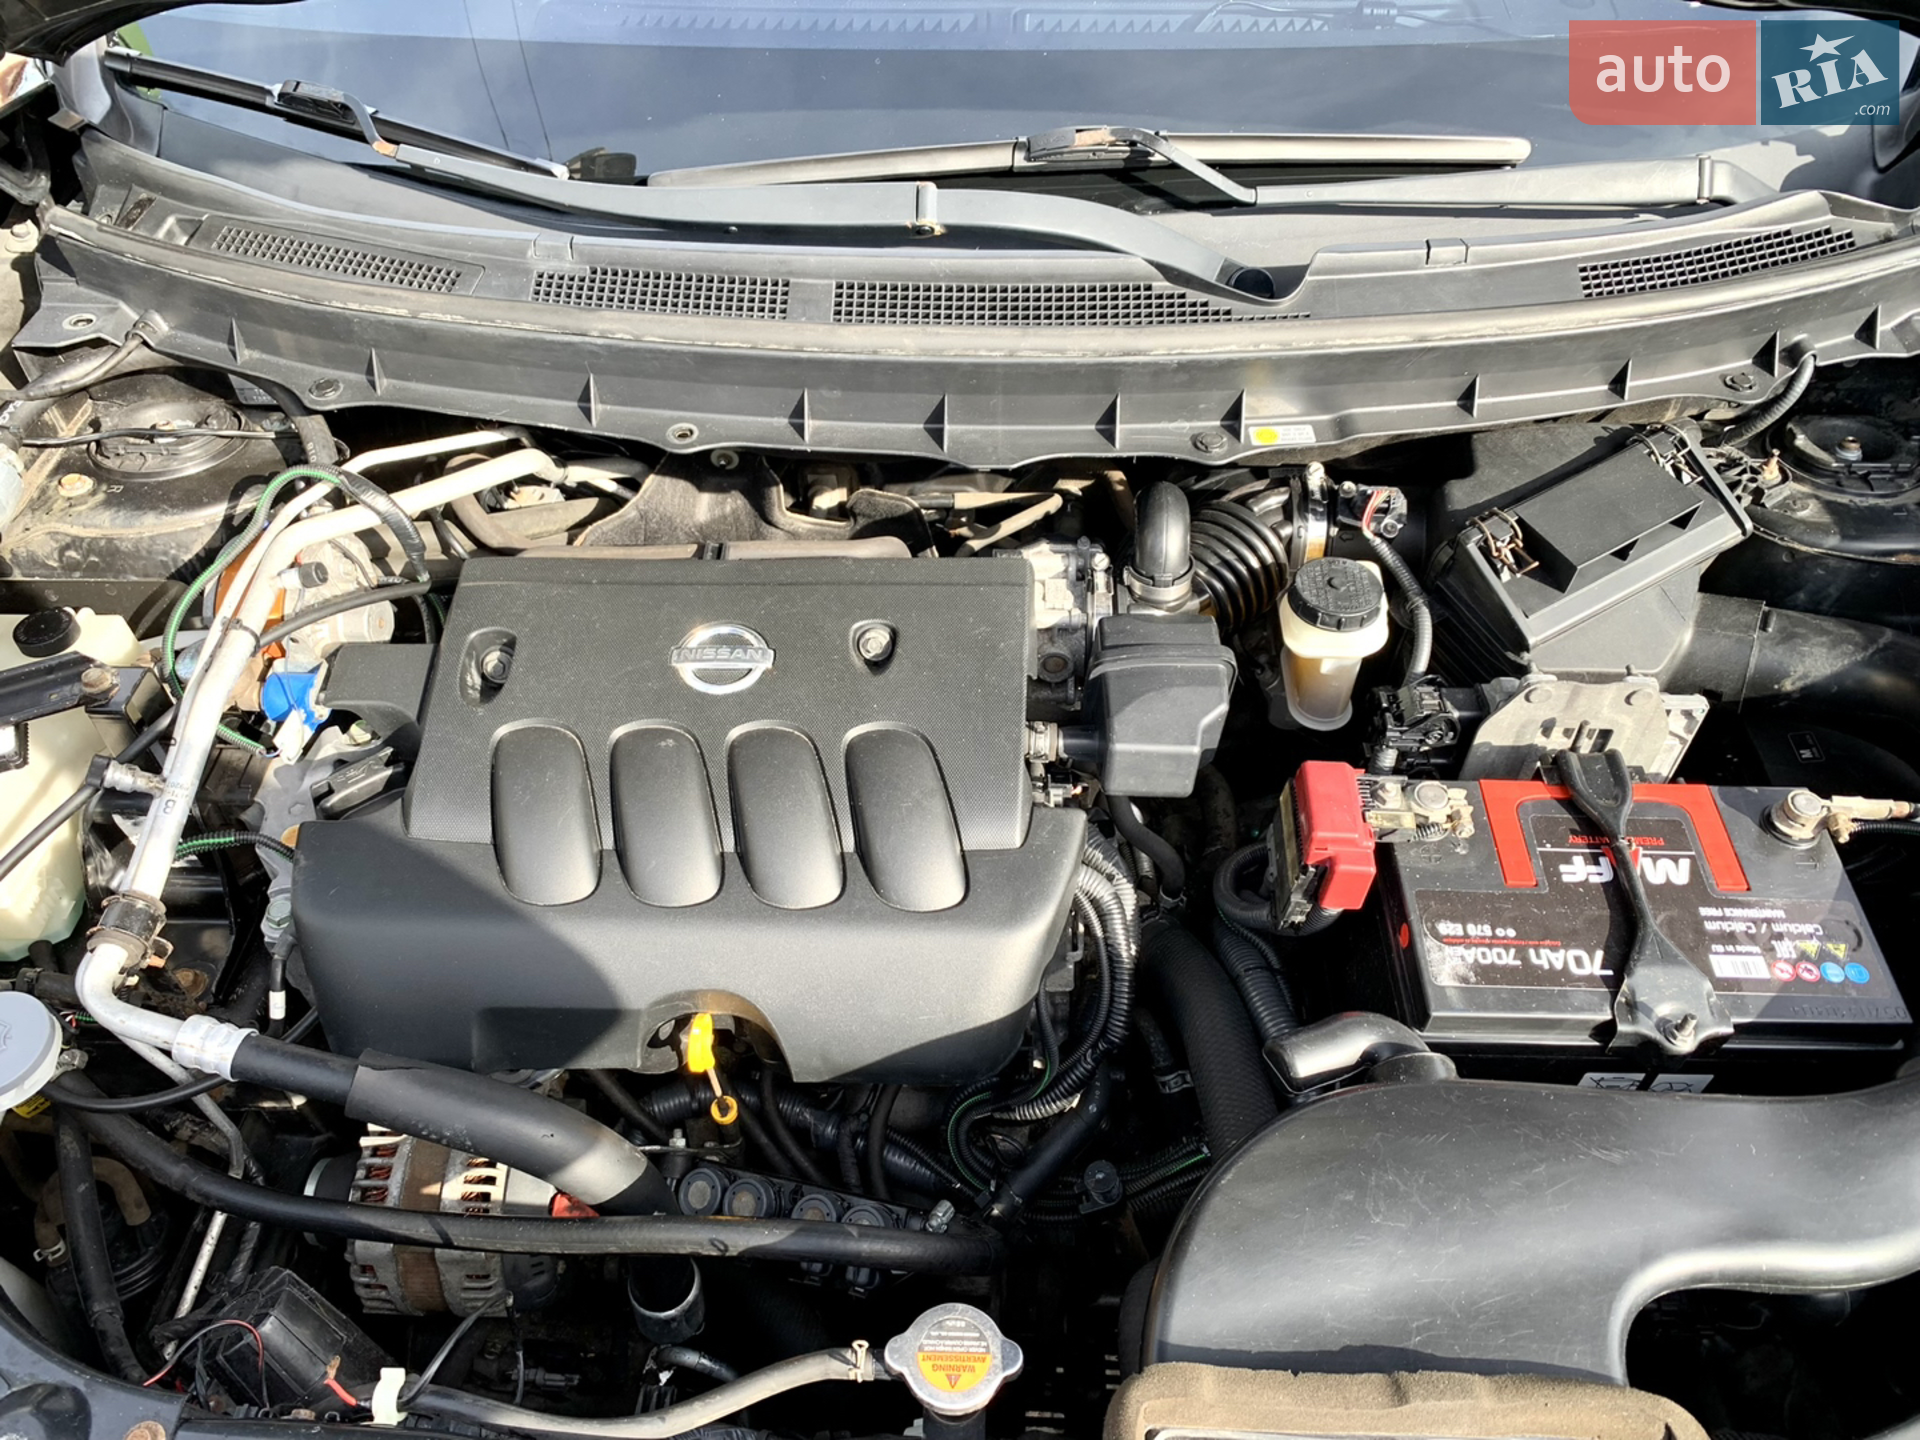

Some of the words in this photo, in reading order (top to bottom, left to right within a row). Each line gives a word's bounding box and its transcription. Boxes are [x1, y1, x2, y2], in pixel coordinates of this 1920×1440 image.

[679, 647, 763, 661] NISSAN
[1703, 920, 1757, 934] Calcium
[1771, 922, 1823, 936] Calcium
[1528, 946, 1615, 976] 70Ah
[921, 1354, 987, 1363] AVERTISSEMENT
[931, 1363, 976, 1373] WARNING
